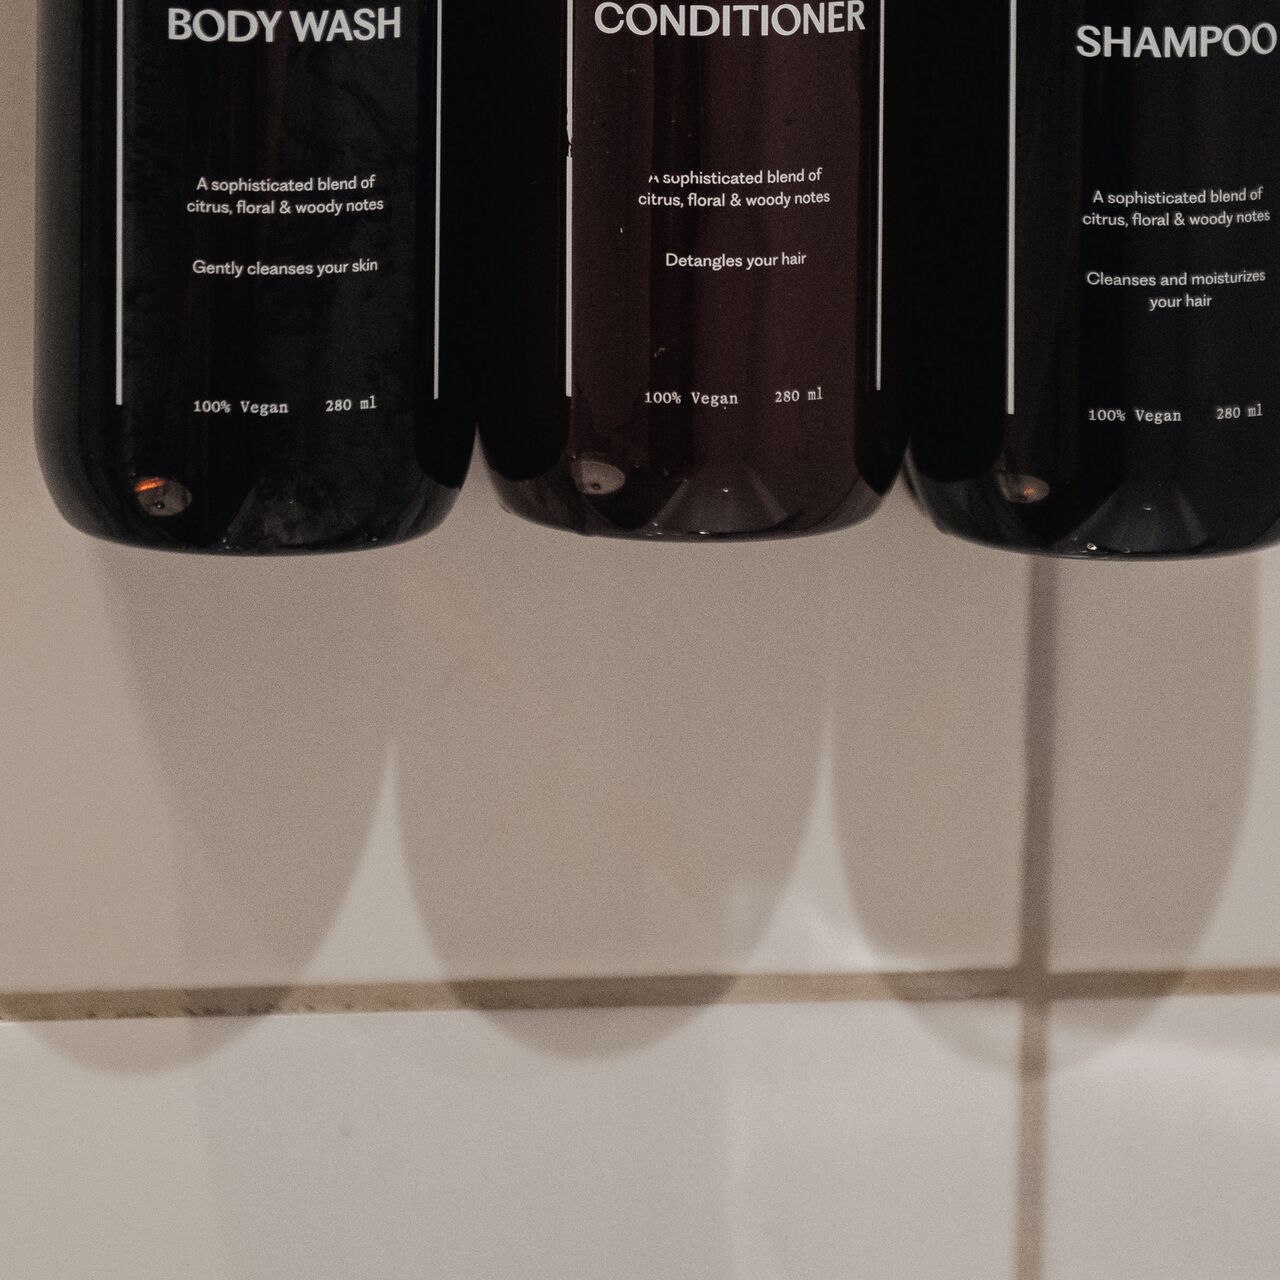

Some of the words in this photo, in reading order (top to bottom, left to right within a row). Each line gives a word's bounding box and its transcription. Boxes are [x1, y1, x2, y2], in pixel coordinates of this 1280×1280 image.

[167, 7, 283, 43] BODY
[289, 6, 401, 43] WASH
[594, 0, 866, 37] CONDITIONER
[1076, 22, 1278, 58] SHAMPOO
[196, 176, 209, 191] A
[211, 177, 314, 195] sophisticated
[317, 175, 357, 191] blend
[360, 173, 377, 189] of
[662, 169, 763, 188] sophisticated
[766, 168, 805, 184] blend
[808, 166, 823, 182] of
[186, 199, 233, 215] citrus,
[235, 199, 275, 215] floral
[279, 199, 292, 215] &
[295, 198, 343, 217] woody
[346, 198, 384, 212] notes
[637, 192, 684, 209] citrus,
[687, 192, 726, 207] floral
[729, 192, 742, 207] &
[745, 191, 792, 209] woody
[794, 191, 831, 205] notes
[1092, 190, 1104, 204] A
[1107, 189, 1207, 208] sophisticated
[1210, 187, 1247, 203] blend
[1249, 185, 1264, 201] of
[1082, 212, 1129, 228] citrus,
[1131, 212, 1170, 227] floral
[1173, 212, 1186, 227] &
[1188, 210, 1234, 228] woody
[1236, 210, 1271, 224] notes
[192, 259, 244, 279] Gently
[246, 260, 314, 276] cleanses
[316, 263, 350, 278] your
[351, 257, 378, 273] skin
[665, 252, 743, 272] Detangles
[745, 256, 779, 271] your
[781, 251, 808, 266] hair
[1086, 271, 1157, 287] Cleanses
[1160, 271, 1188, 287] and
[1191, 269, 1266, 286] moisturizes
[1149, 298, 1183, 312] your
[1185, 293, 1213, 308] hair
[193, 399, 231, 414] 100%
[240, 400, 289, 417] Vegan
[325, 398, 352, 412] 280
[359, 394, 377, 410] ml
[644, 391, 682, 405] 100%
[690, 391, 739, 407] Vegan
[774, 389, 800, 403] 280
[807, 386, 824, 401] ml
[1088, 409, 1126, 422] 100%
[1134, 409, 1182, 425] Vegan
[1216, 406, 1241, 420] 280
[1247, 402, 1263, 417] ml
